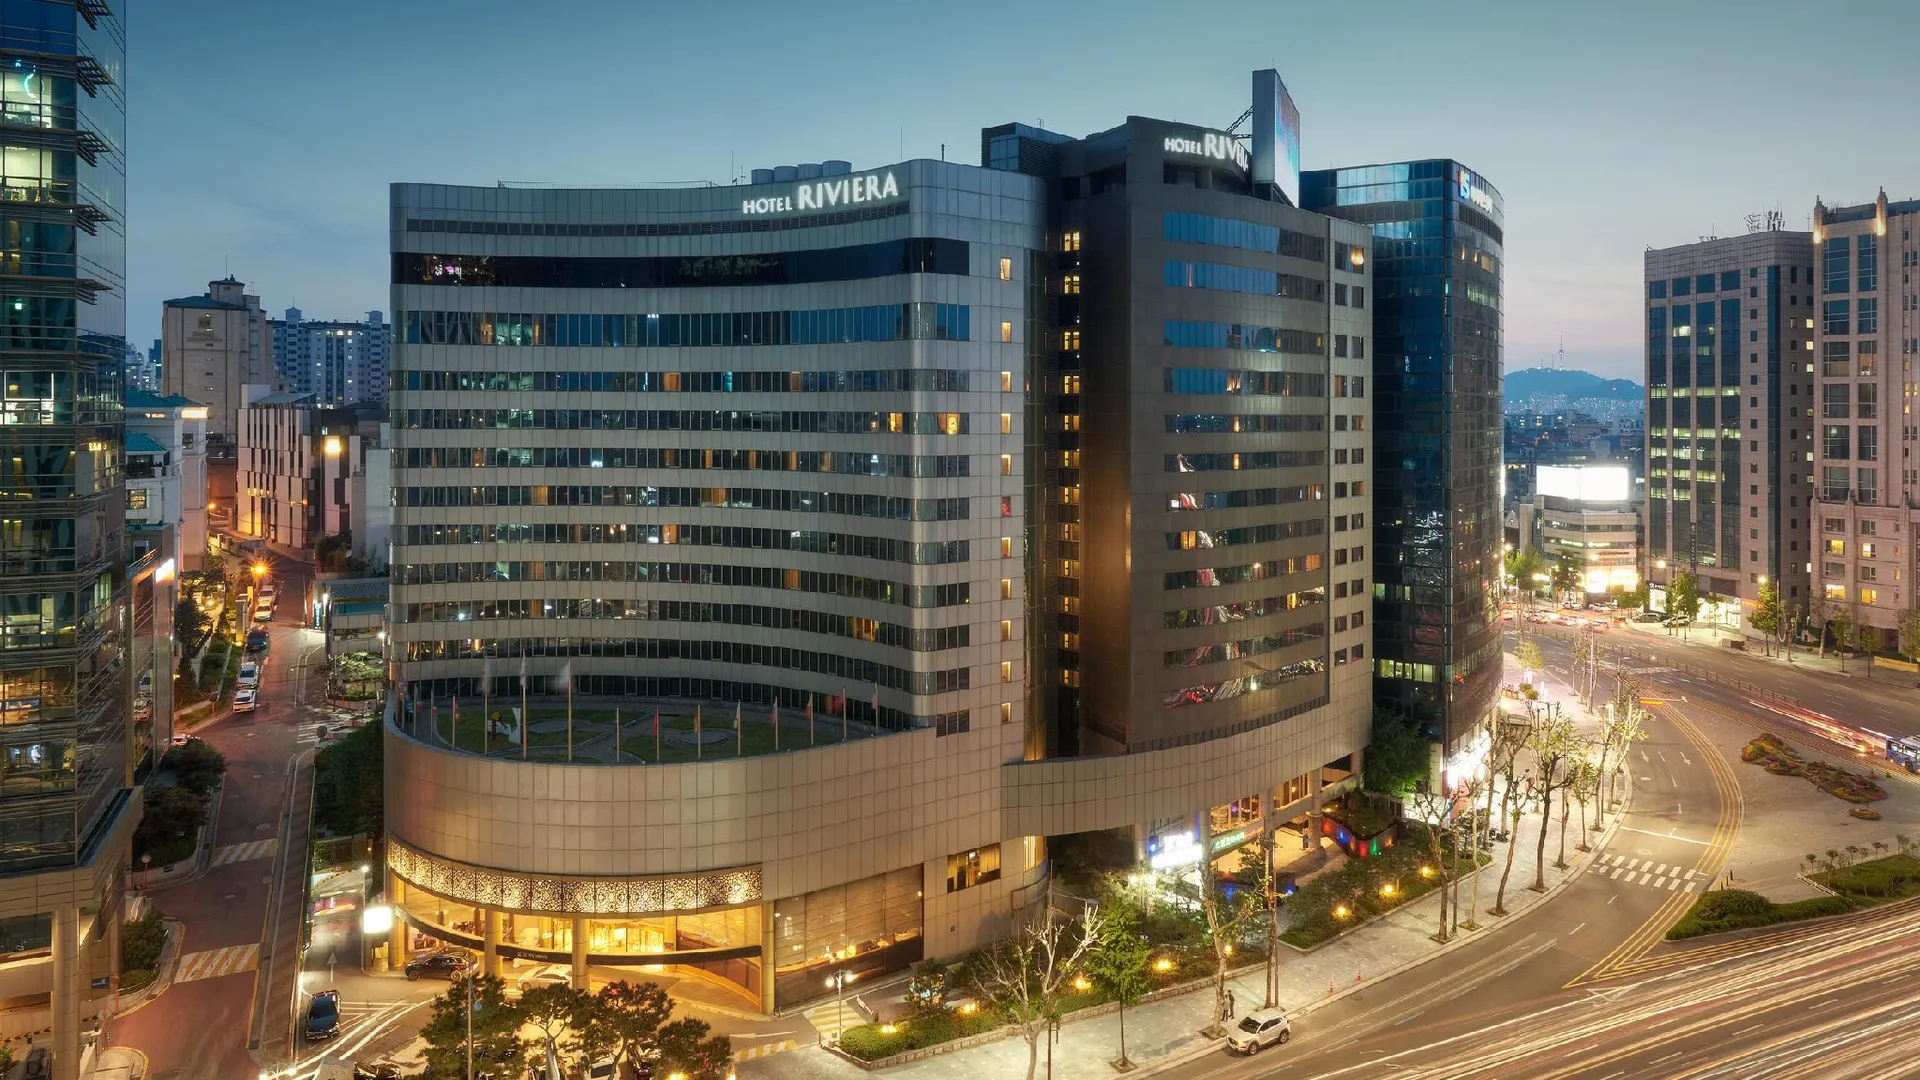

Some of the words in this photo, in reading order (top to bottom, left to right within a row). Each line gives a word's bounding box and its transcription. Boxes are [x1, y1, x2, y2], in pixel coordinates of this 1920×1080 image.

[1164, 137, 1203, 155] HOTEL
[742, 195, 793, 214] HOTEL
[798, 171, 898, 210] RIVIERA
